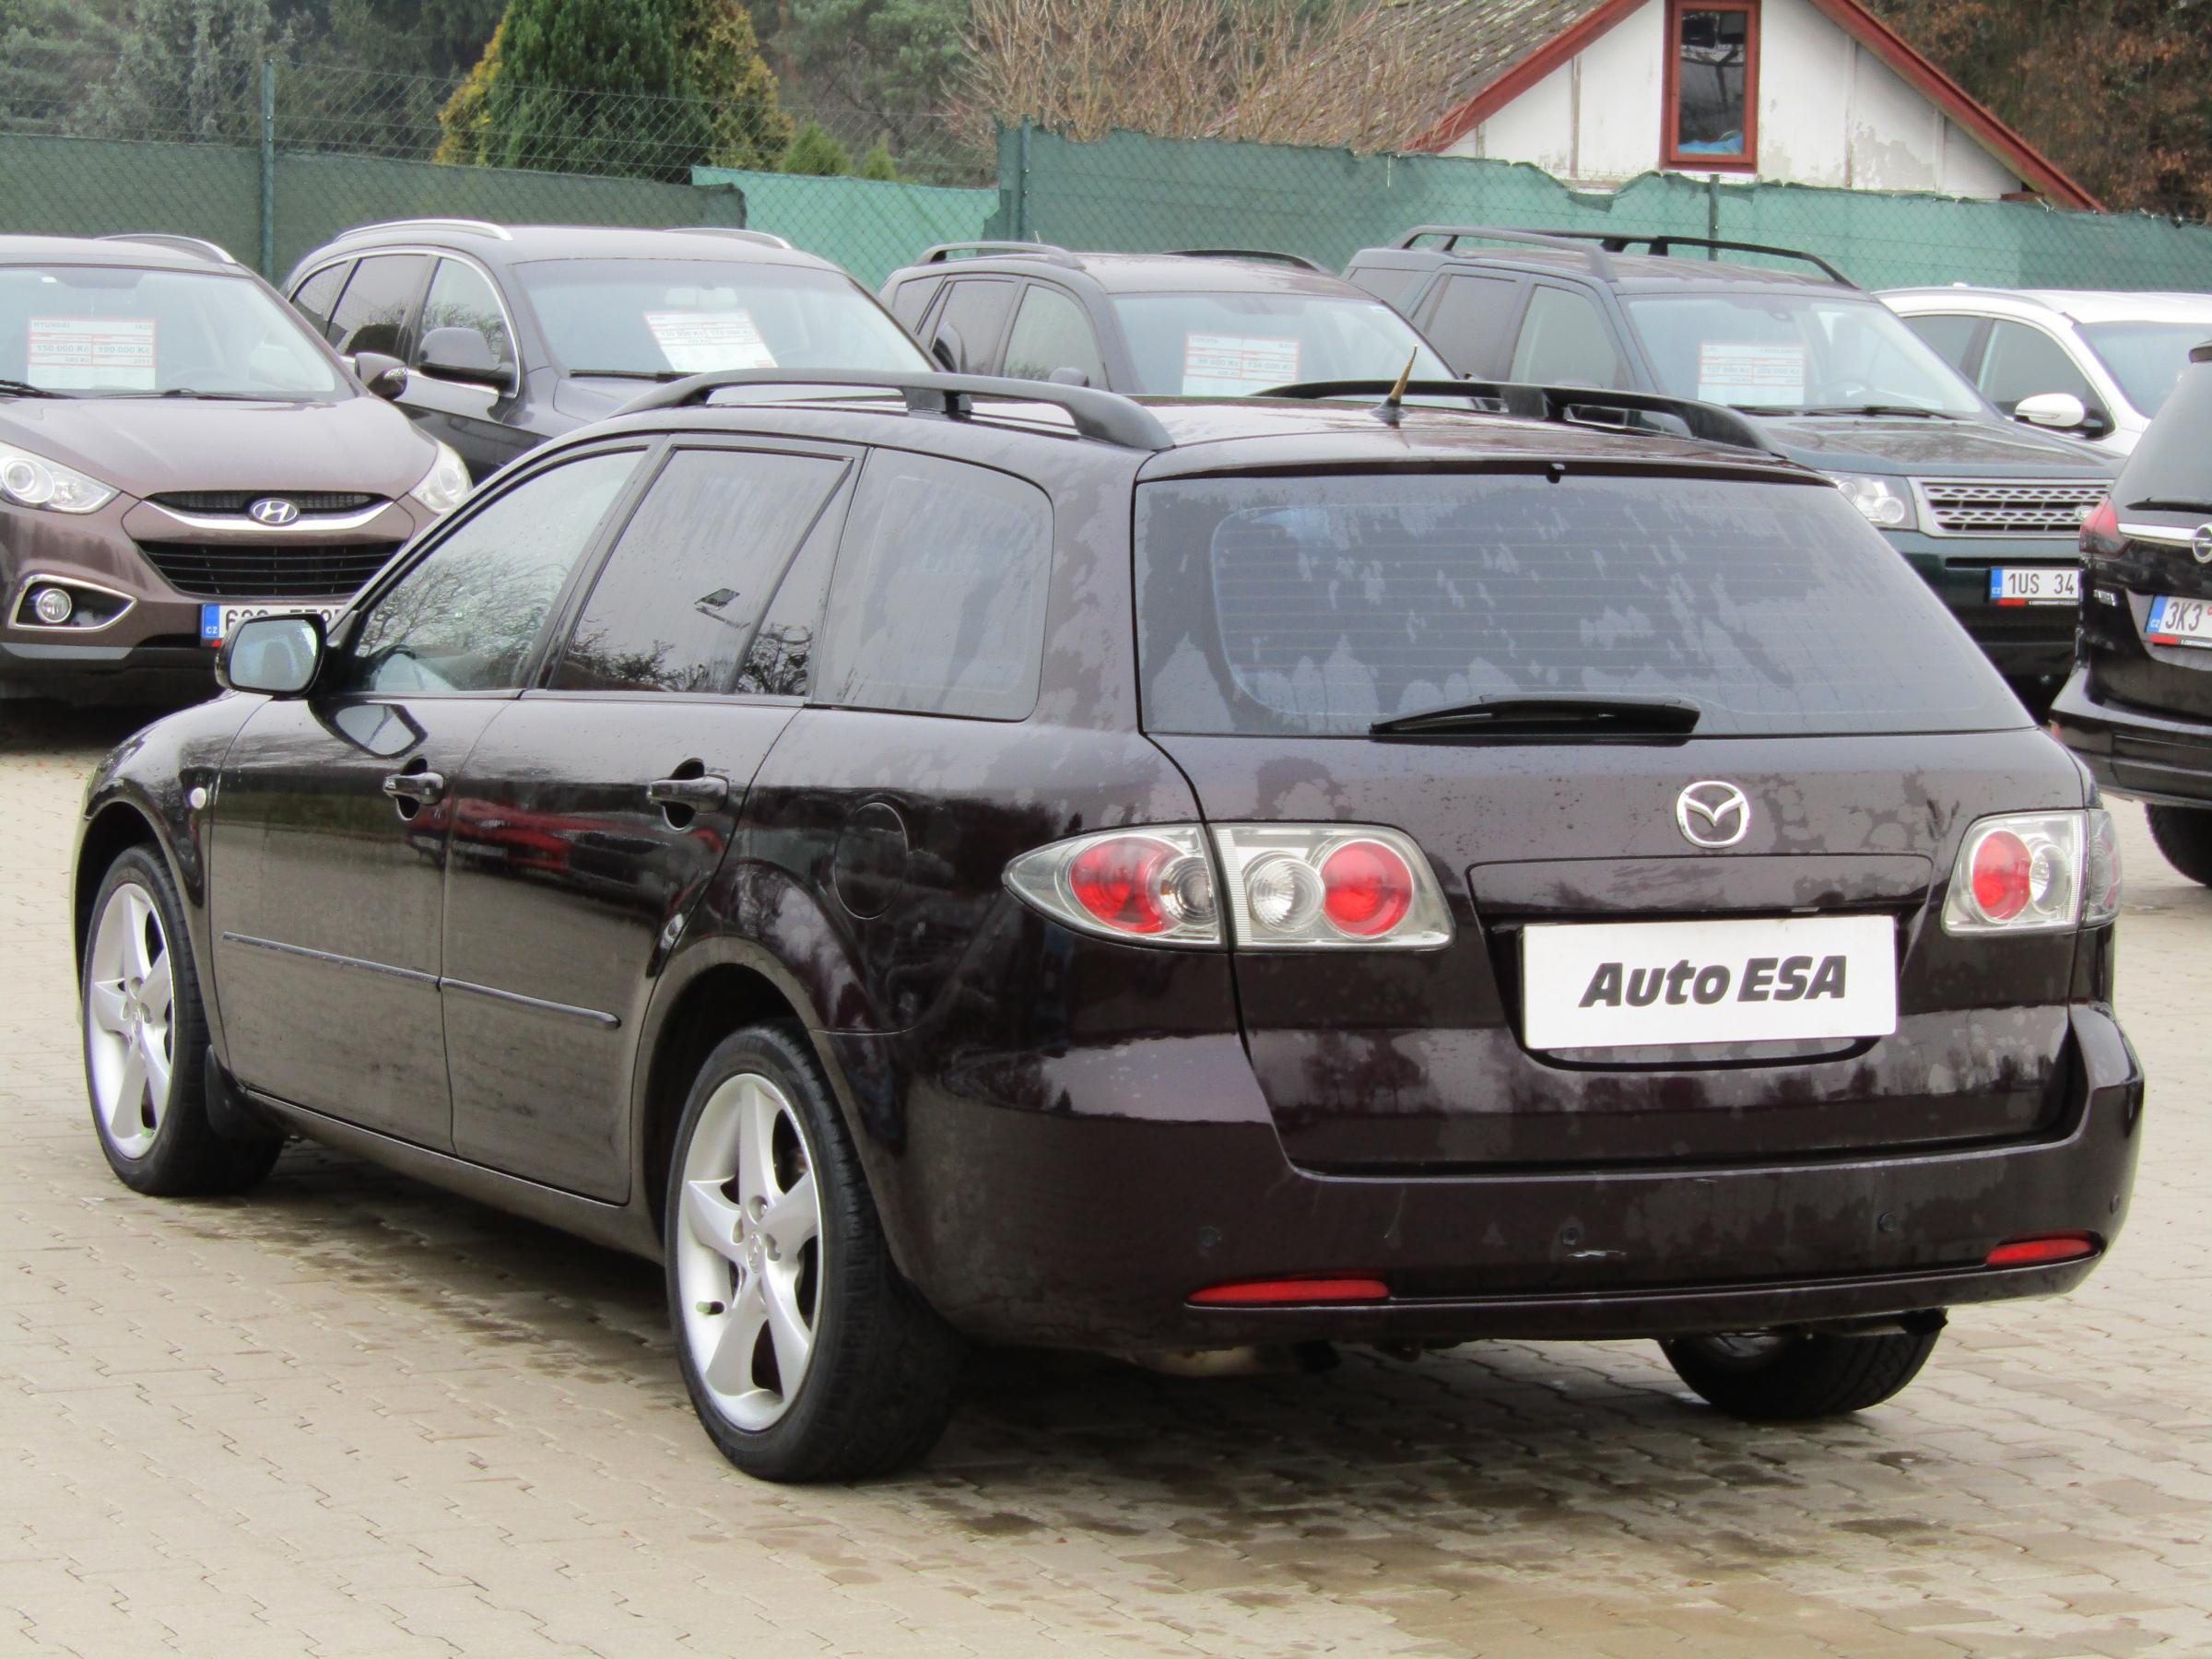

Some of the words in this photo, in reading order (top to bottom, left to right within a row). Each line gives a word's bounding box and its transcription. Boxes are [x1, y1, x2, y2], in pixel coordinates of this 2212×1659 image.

[2008, 572, 2040, 594] 1US
[2053, 573, 2075, 594] 34
[2165, 601, 2203, 632] 3K3
[206, 626, 218, 634] CZ
[1578, 959, 1731, 1008] Auto
[1737, 955, 1847, 1003] ESA
